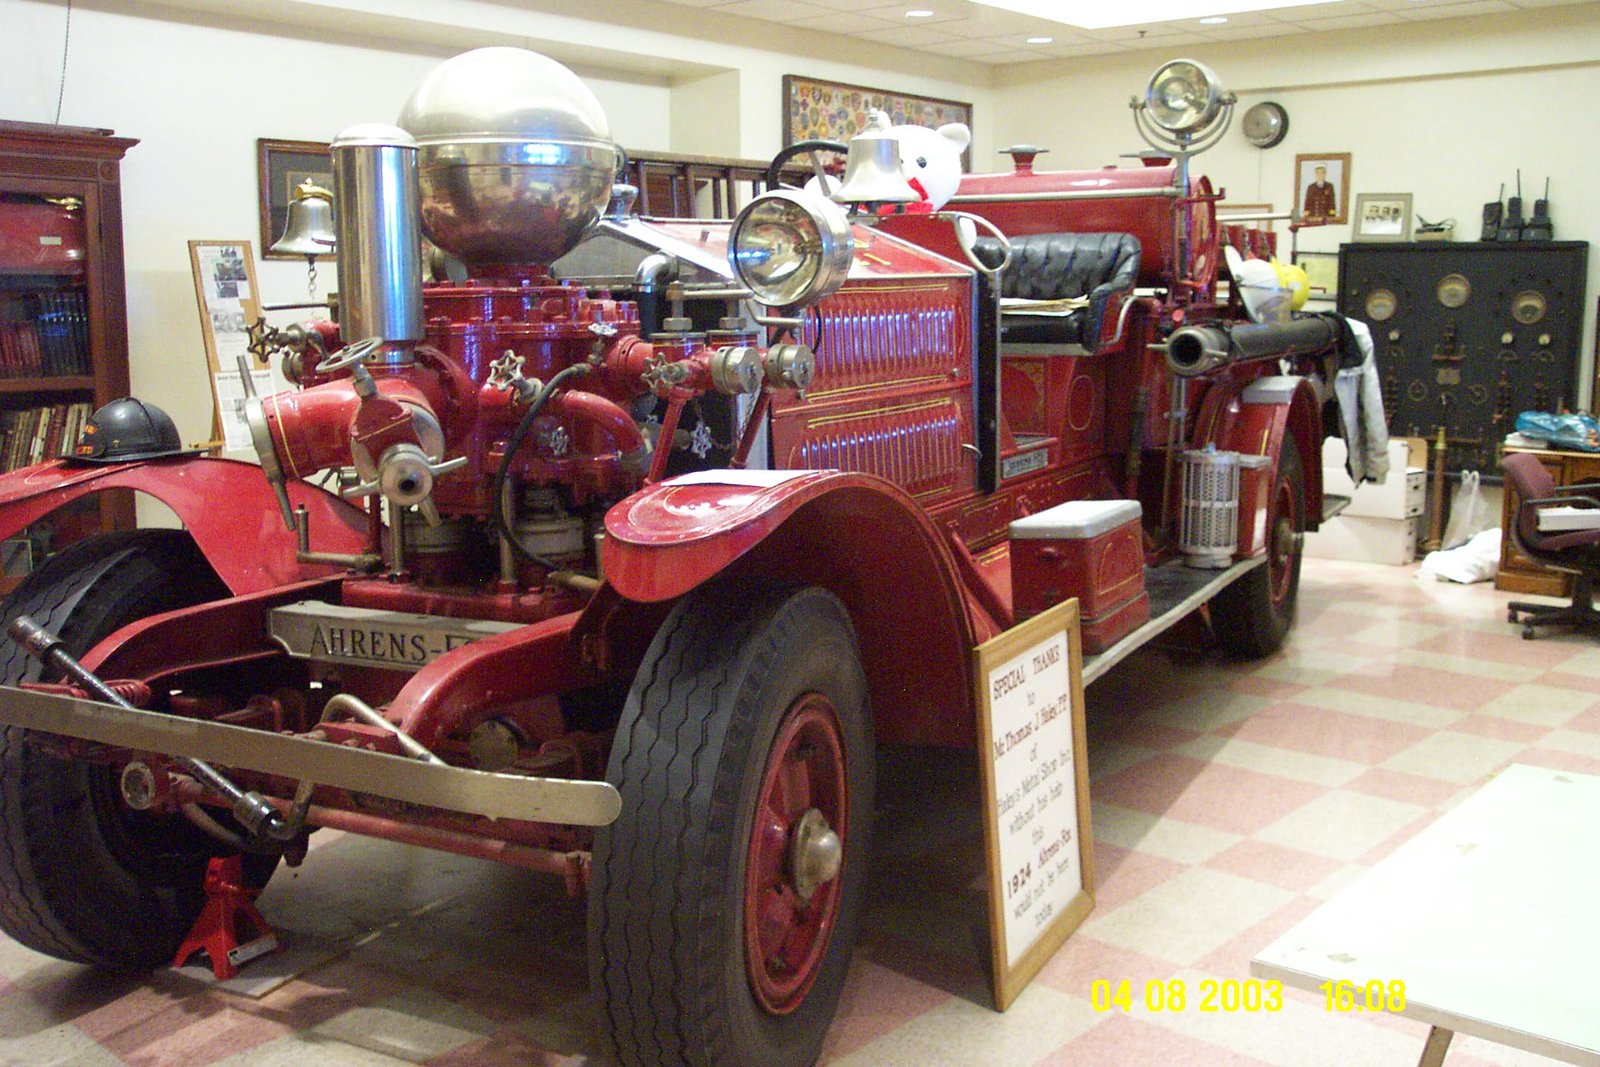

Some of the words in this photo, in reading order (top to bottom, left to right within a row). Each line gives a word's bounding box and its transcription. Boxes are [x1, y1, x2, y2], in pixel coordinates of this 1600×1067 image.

[310, 623, 473, 661] AHRENS-F
[993, 665, 1026, 700] SPECIAL
[1032, 645, 1060, 675] THANKS
[1005, 720, 1032, 751] Thomas
[1008, 861, 1032, 899] 1924
